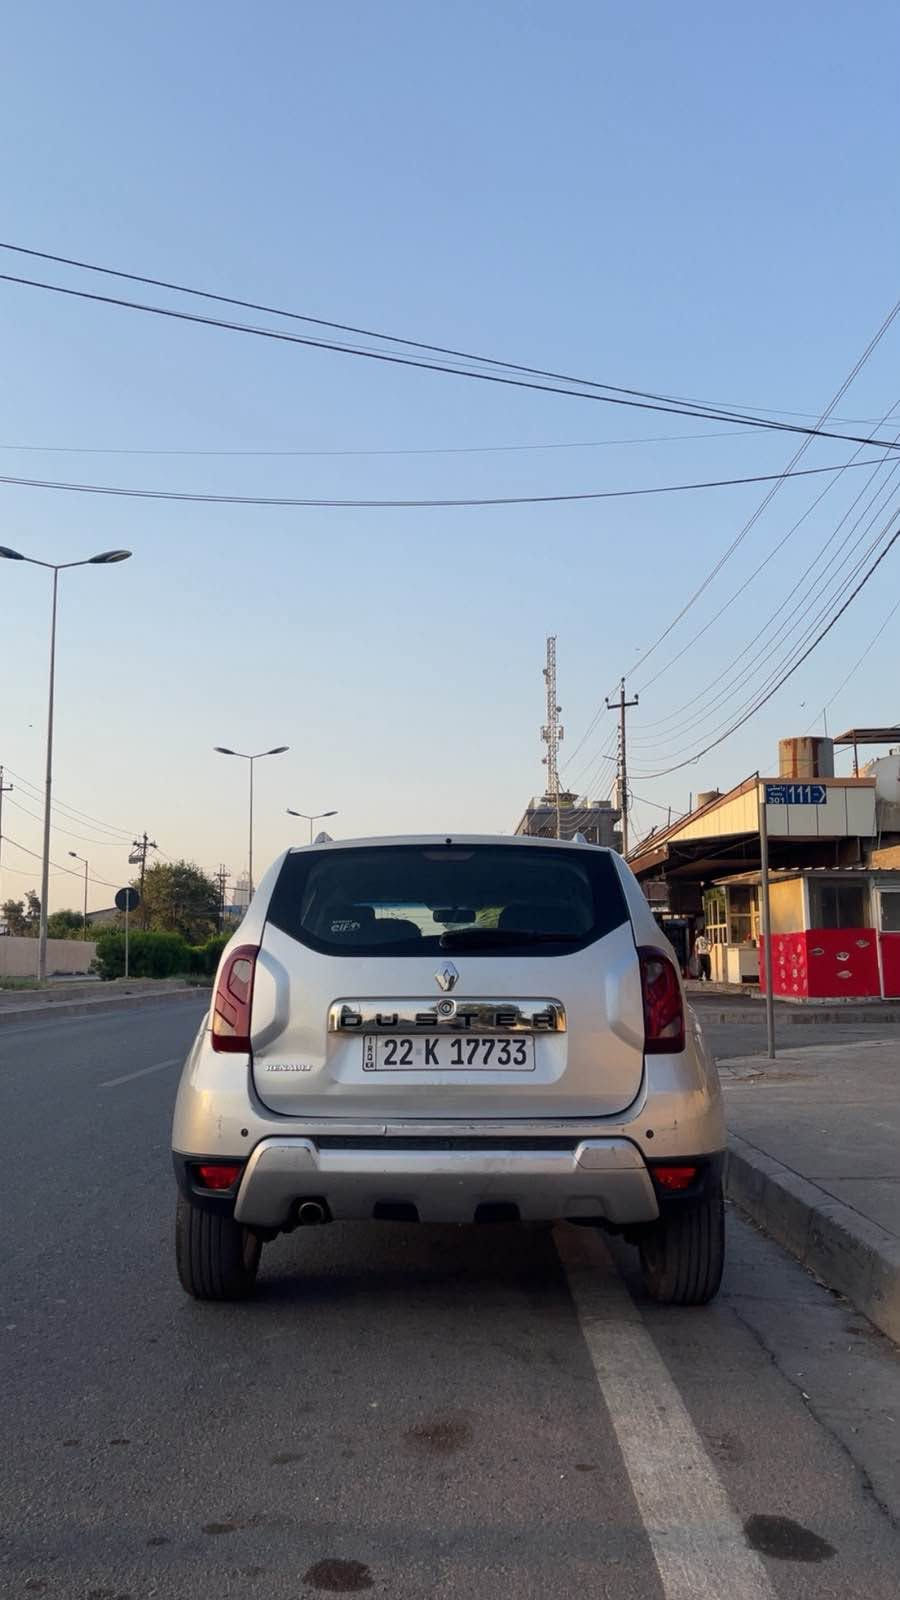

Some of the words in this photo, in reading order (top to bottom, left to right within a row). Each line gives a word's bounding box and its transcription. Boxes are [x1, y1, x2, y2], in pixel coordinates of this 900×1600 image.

[788, 785, 811, 803] 111
[340, 1013, 553, 1027] DUSTER
[384, 1038, 413, 1066] 22
[425, 1038, 439, 1065] K
[451, 1038, 527, 1066] 17733
